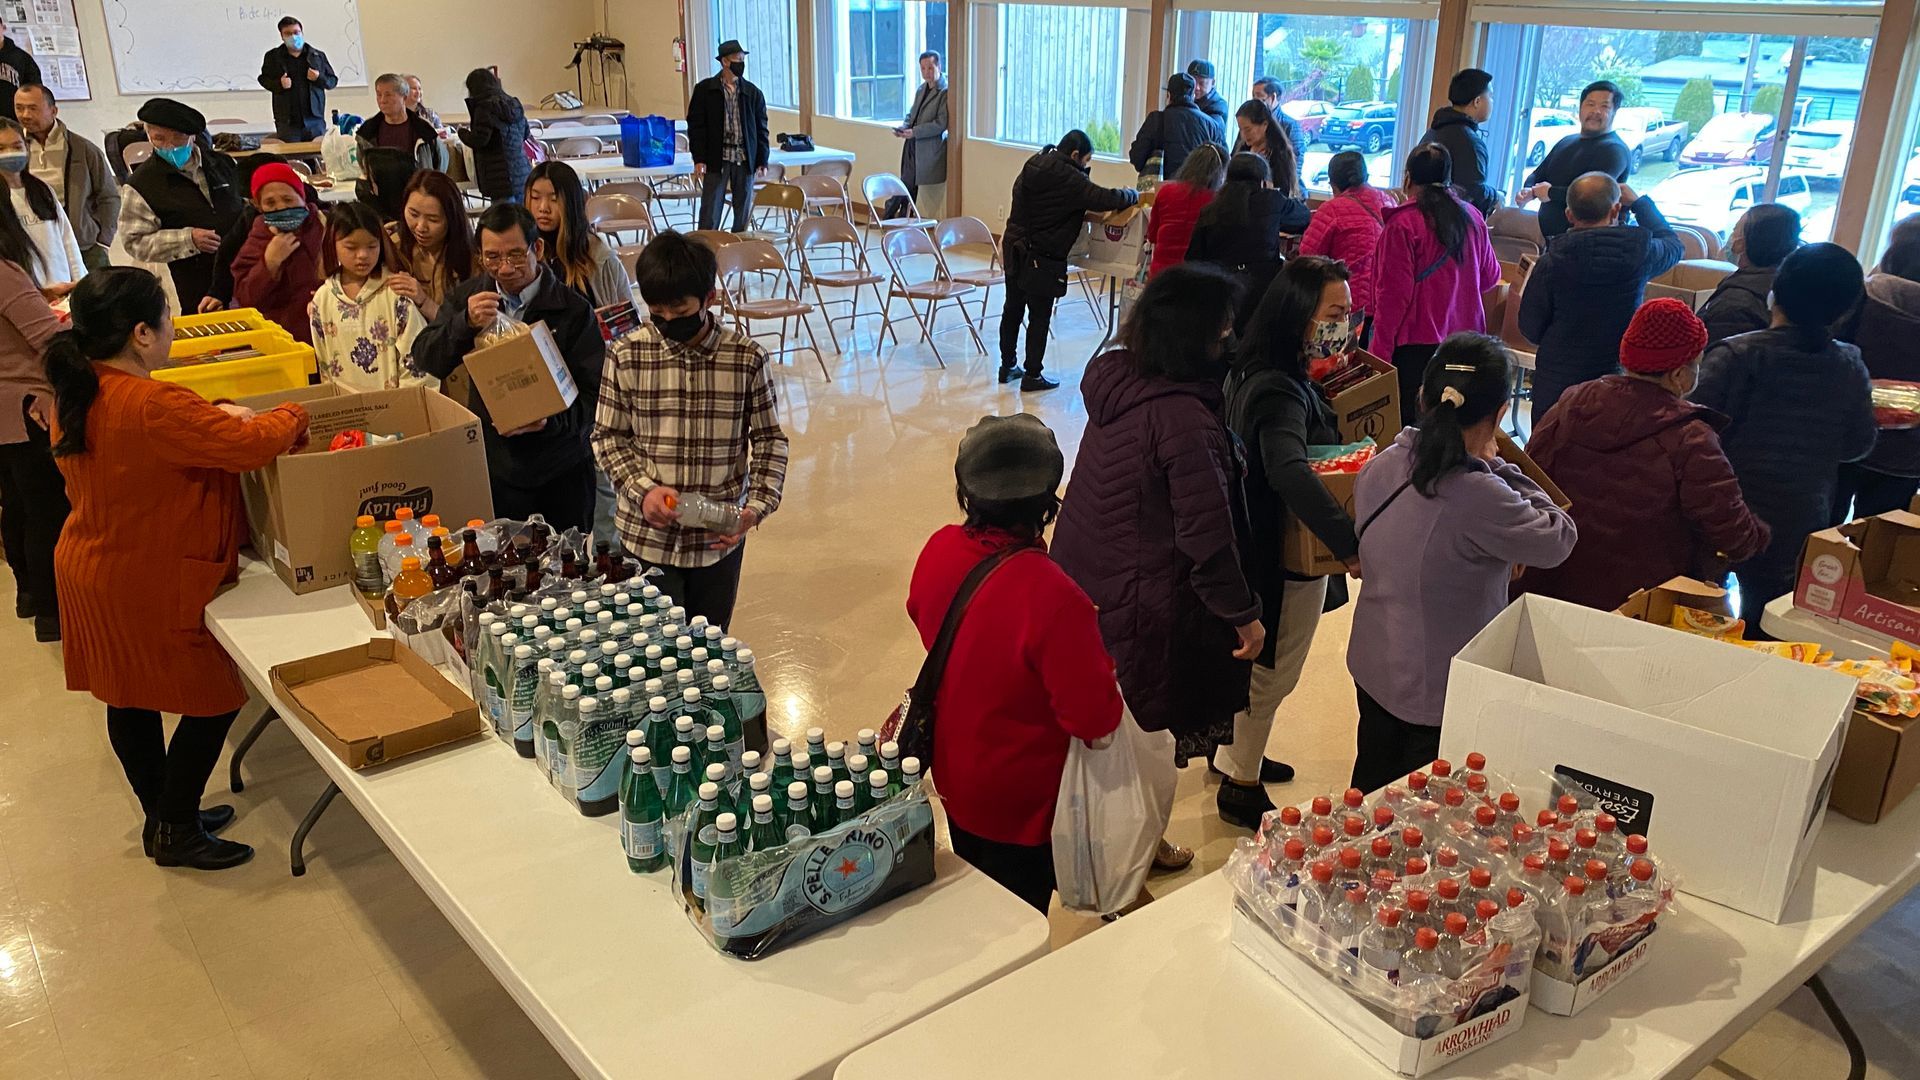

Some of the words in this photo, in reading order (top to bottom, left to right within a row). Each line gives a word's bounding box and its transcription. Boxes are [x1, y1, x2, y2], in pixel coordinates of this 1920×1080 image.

[314, 410, 341, 420] LABELED
[360, 481, 379, 498] fun!
[382, 482, 406, 491] Good
[1854, 604, 1915, 635] Artisan
[1433, 1009, 1511, 1057] ARROWHEAD
